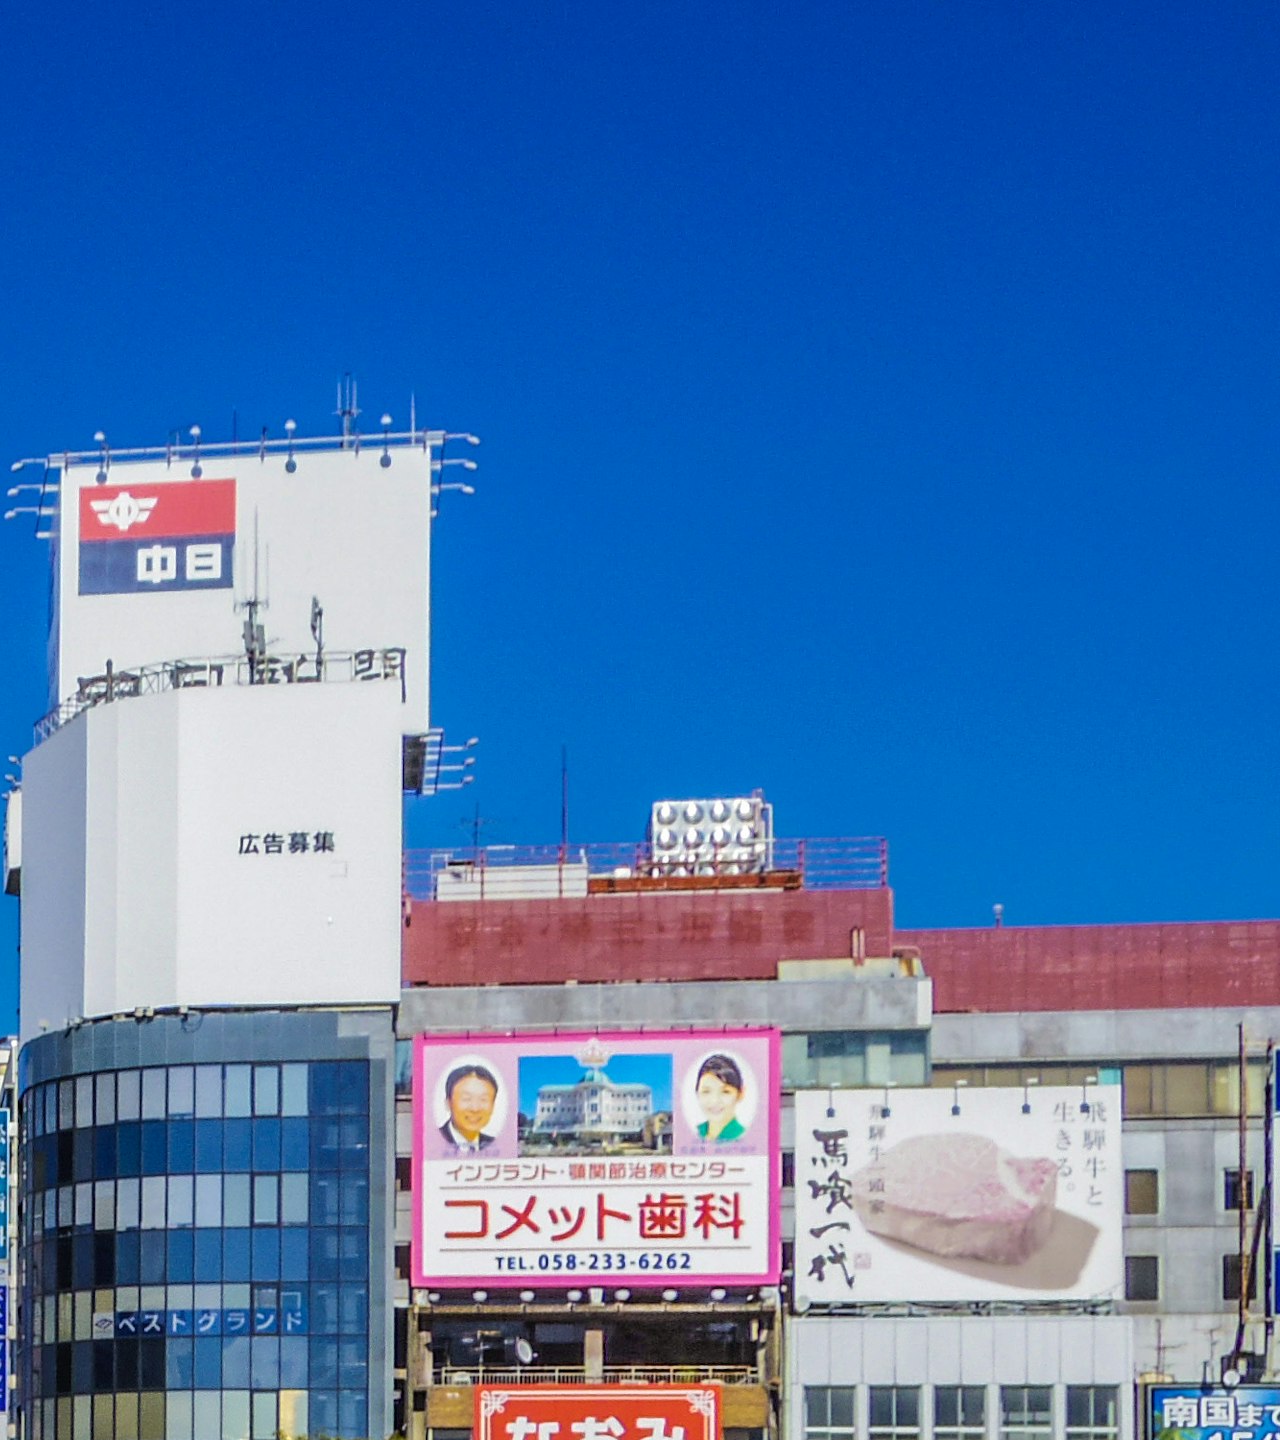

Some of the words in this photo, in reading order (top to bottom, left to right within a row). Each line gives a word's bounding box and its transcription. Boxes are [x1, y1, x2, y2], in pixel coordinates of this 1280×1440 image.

[137, 543, 222, 583] 中日
[238, 830, 336, 856] 広告募集
[446, 1161, 745, 1182] インプラント・顎関節治療センター
[444, 1192, 745, 1242] コメット歯科
[118, 1311, 303, 1332] ベストグランド
